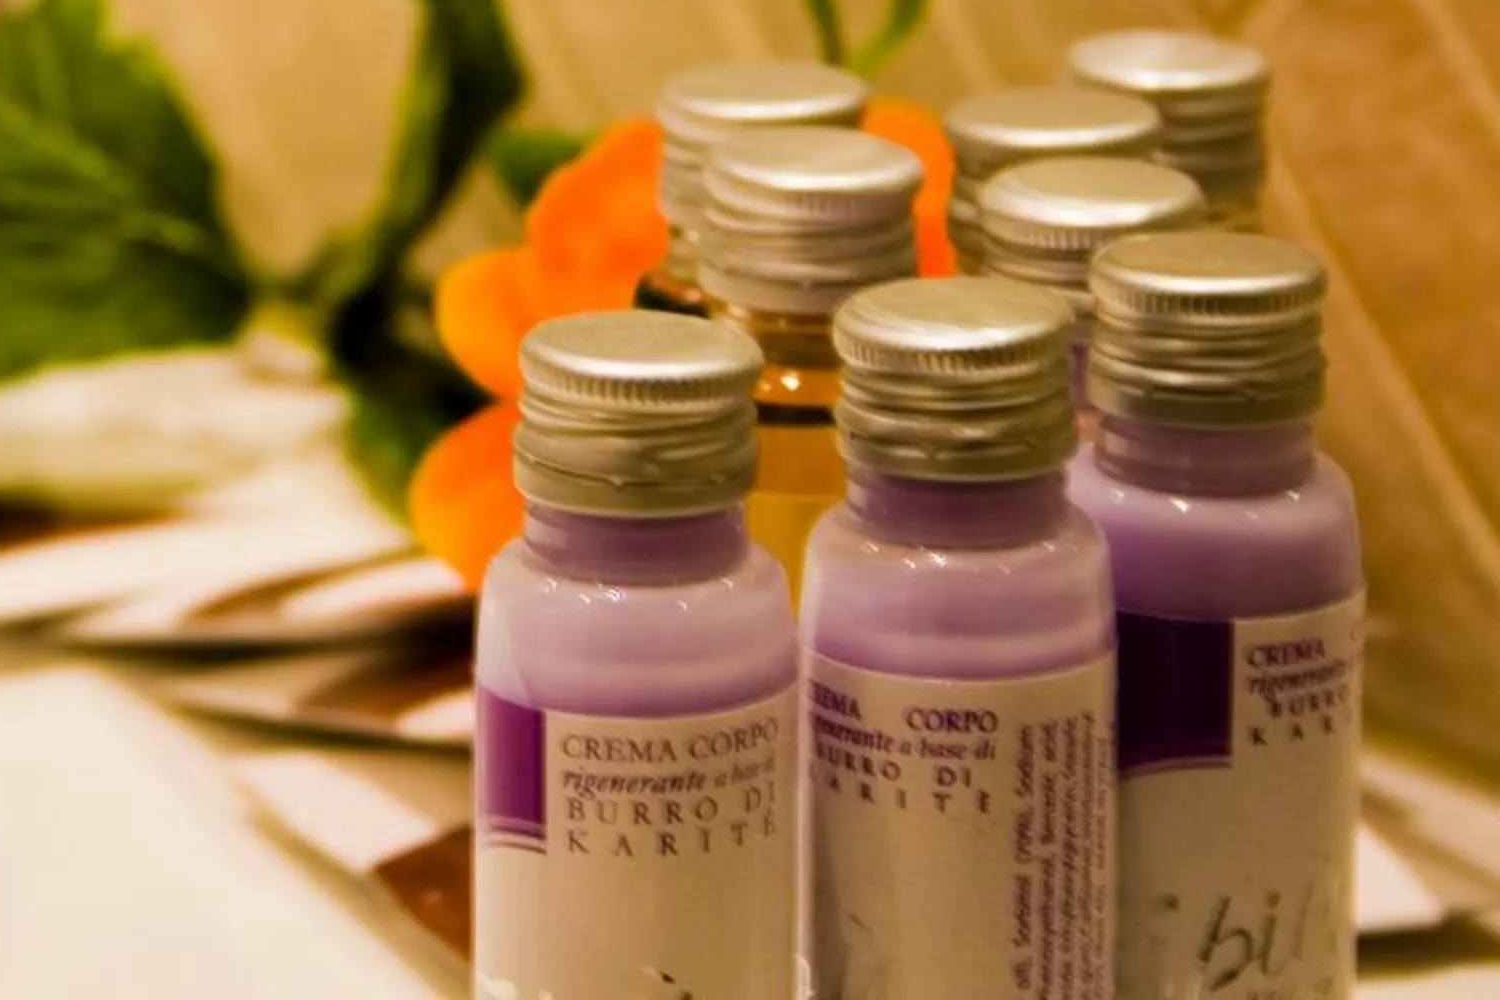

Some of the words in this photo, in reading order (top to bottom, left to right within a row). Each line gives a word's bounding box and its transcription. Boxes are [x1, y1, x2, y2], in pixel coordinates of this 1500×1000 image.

[905, 707, 999, 734] CORPO
[562, 733, 678, 762] CREMA
[688, 717, 779, 759] CORPO
[920, 738, 967, 760] base
[974, 740, 996, 761] di
[562, 766, 707, 798] rigenerante
[936, 765, 971, 789] DI
[567, 796, 719, 825] BURRO
[744, 781, 776, 814] DI
